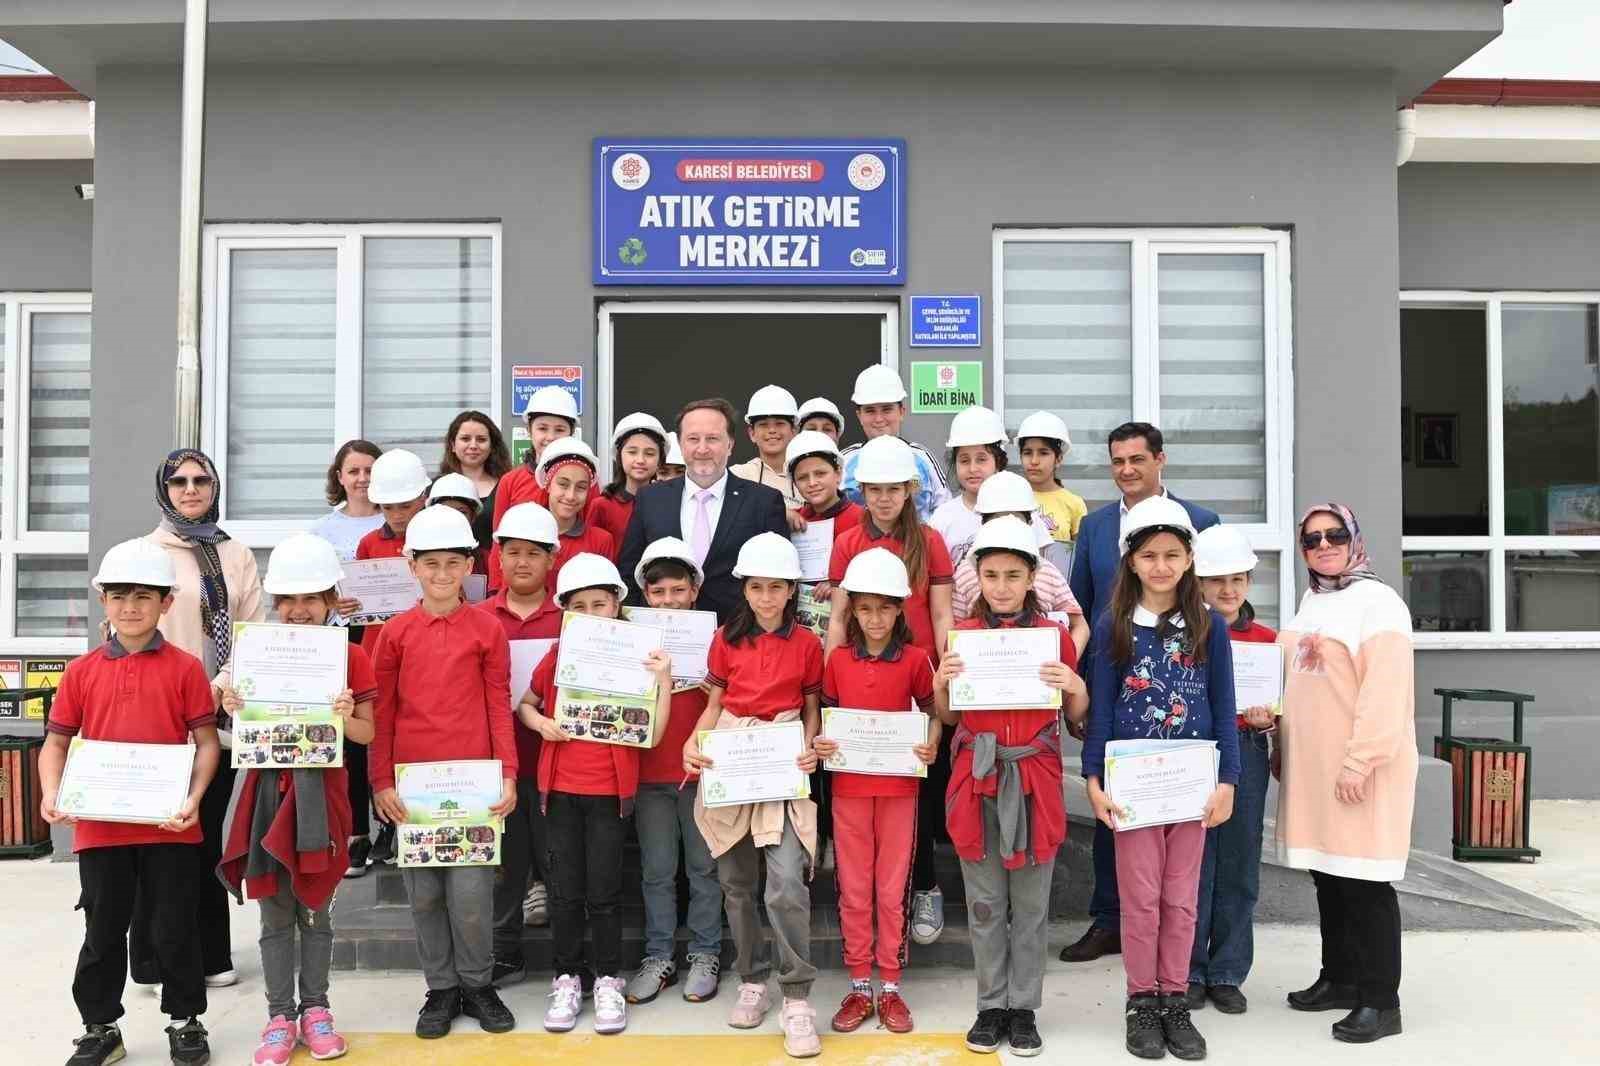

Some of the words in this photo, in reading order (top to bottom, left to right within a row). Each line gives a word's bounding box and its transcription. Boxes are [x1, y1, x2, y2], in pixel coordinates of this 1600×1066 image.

[685, 160, 733, 179] KARESİ
[736, 160, 812, 180] BELEDİYESİ
[639, 195, 715, 228] ATIK
[724, 195, 860, 228] GETİRME
[679, 235, 820, 268] MERKEZİ
[919, 389, 947, 406] İDARİ
[950, 389, 976, 406] BİNA
